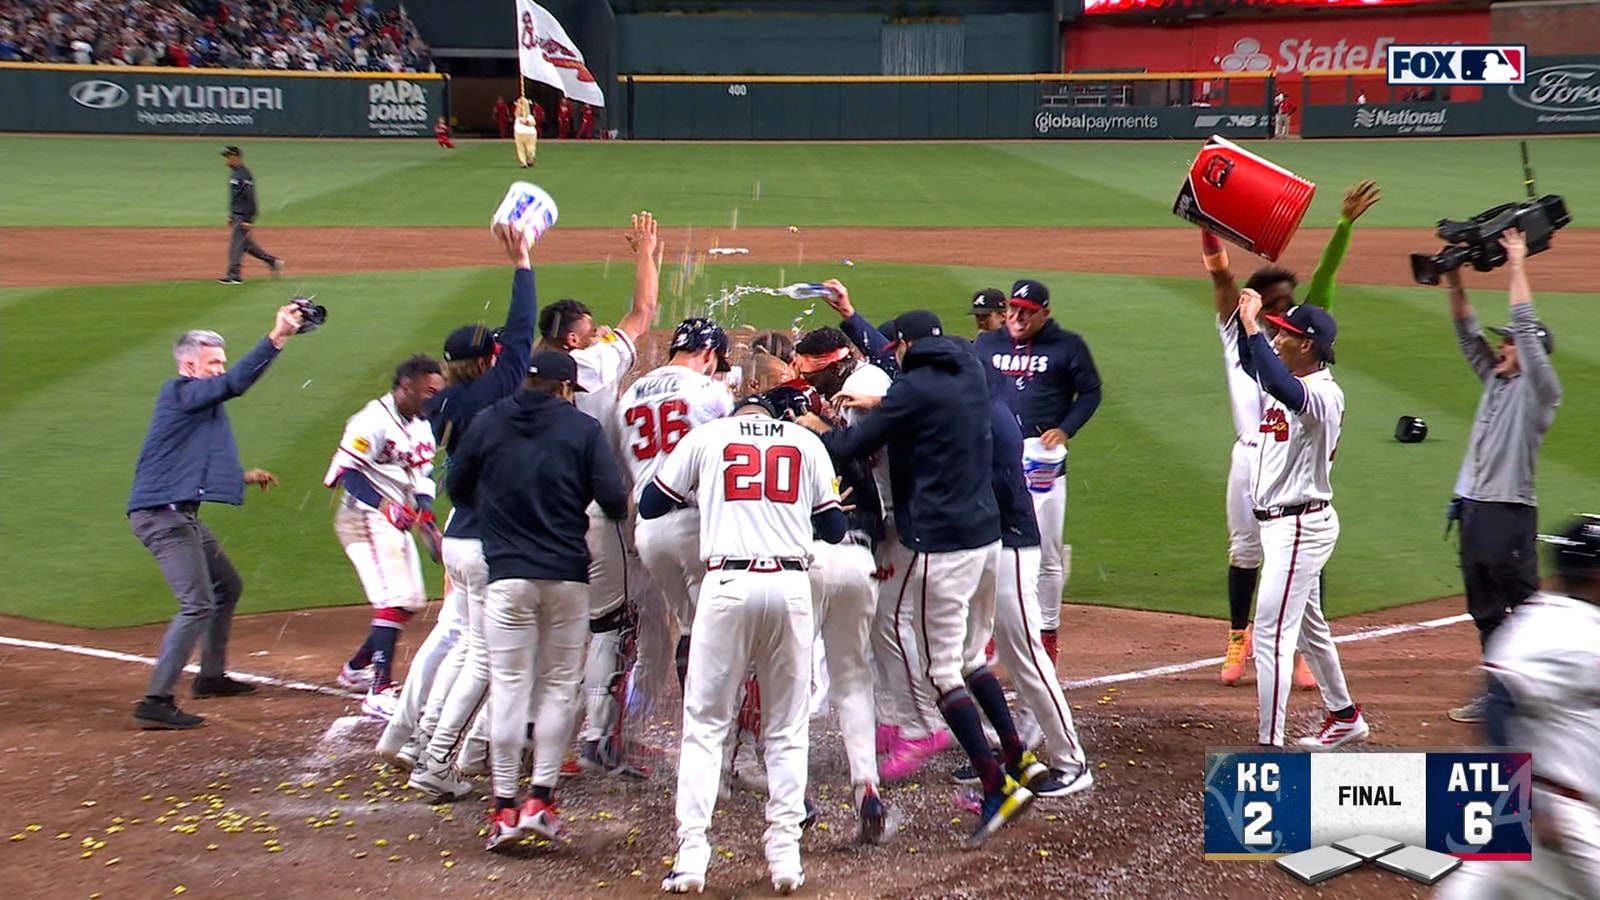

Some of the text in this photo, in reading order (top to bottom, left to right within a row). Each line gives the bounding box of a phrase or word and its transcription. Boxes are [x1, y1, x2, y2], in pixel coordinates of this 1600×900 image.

[1276, 38, 1367, 73] State
[136, 84, 283, 110] HYUNDAI
[368, 80, 426, 103] PAPA
[728, 84, 747, 96] 400
[368, 104, 428, 121] JOHNS
[1035, 112, 1158, 133] globalpayments
[1375, 109, 1446, 126] National
[992, 354, 1049, 373] BRAVES
[635, 375, 682, 399] WHITE
[624, 400, 690, 461] 36
[740, 422, 784, 437] HEIM
[723, 442, 802, 504] 20
